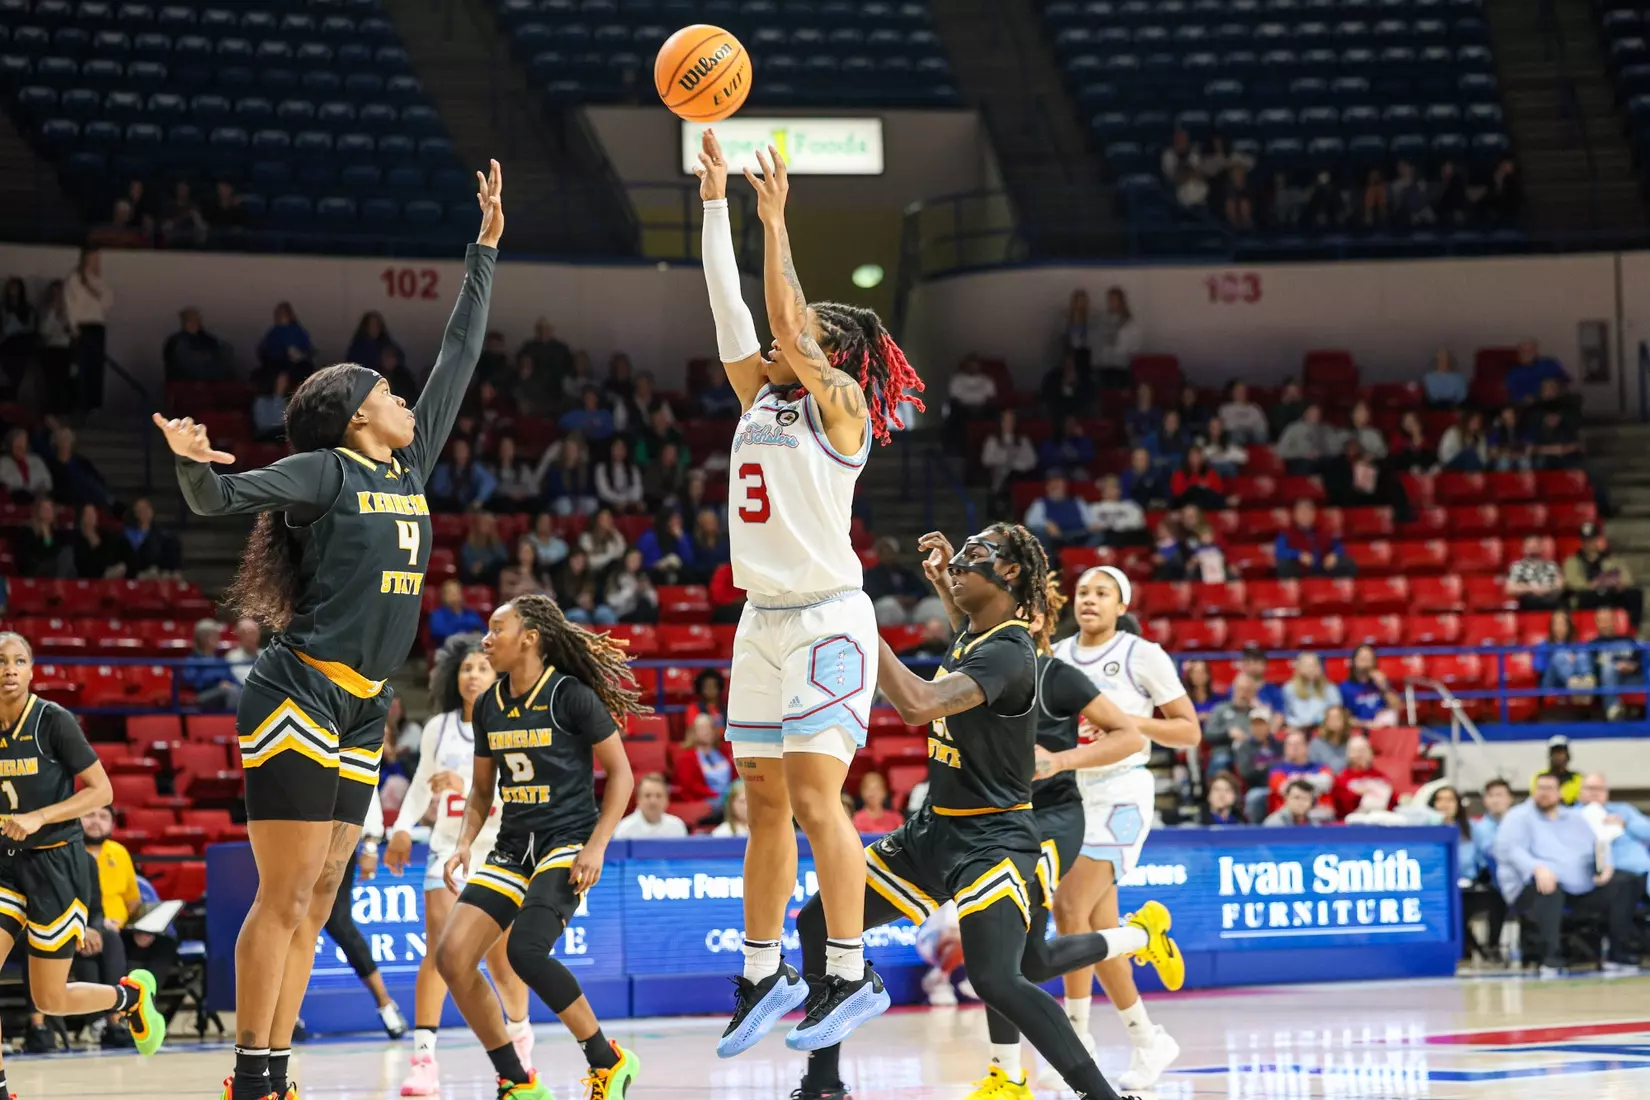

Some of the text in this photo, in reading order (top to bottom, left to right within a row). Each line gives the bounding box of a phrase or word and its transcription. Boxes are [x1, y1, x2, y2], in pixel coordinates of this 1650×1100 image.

[678, 43, 732, 91] Wilson
[380, 267, 440, 300] 102
[1204, 271, 1263, 304] 103
[738, 463, 771, 523] 3
[394, 519, 420, 566] 4
[1, 780, 19, 810] 1
[501, 785, 550, 804] STATE
[637, 874, 693, 900] Your
[1218, 856, 1304, 897] Ivan
[1312, 850, 1423, 894] Smith
[1221, 897, 1422, 929] FURNITURE
